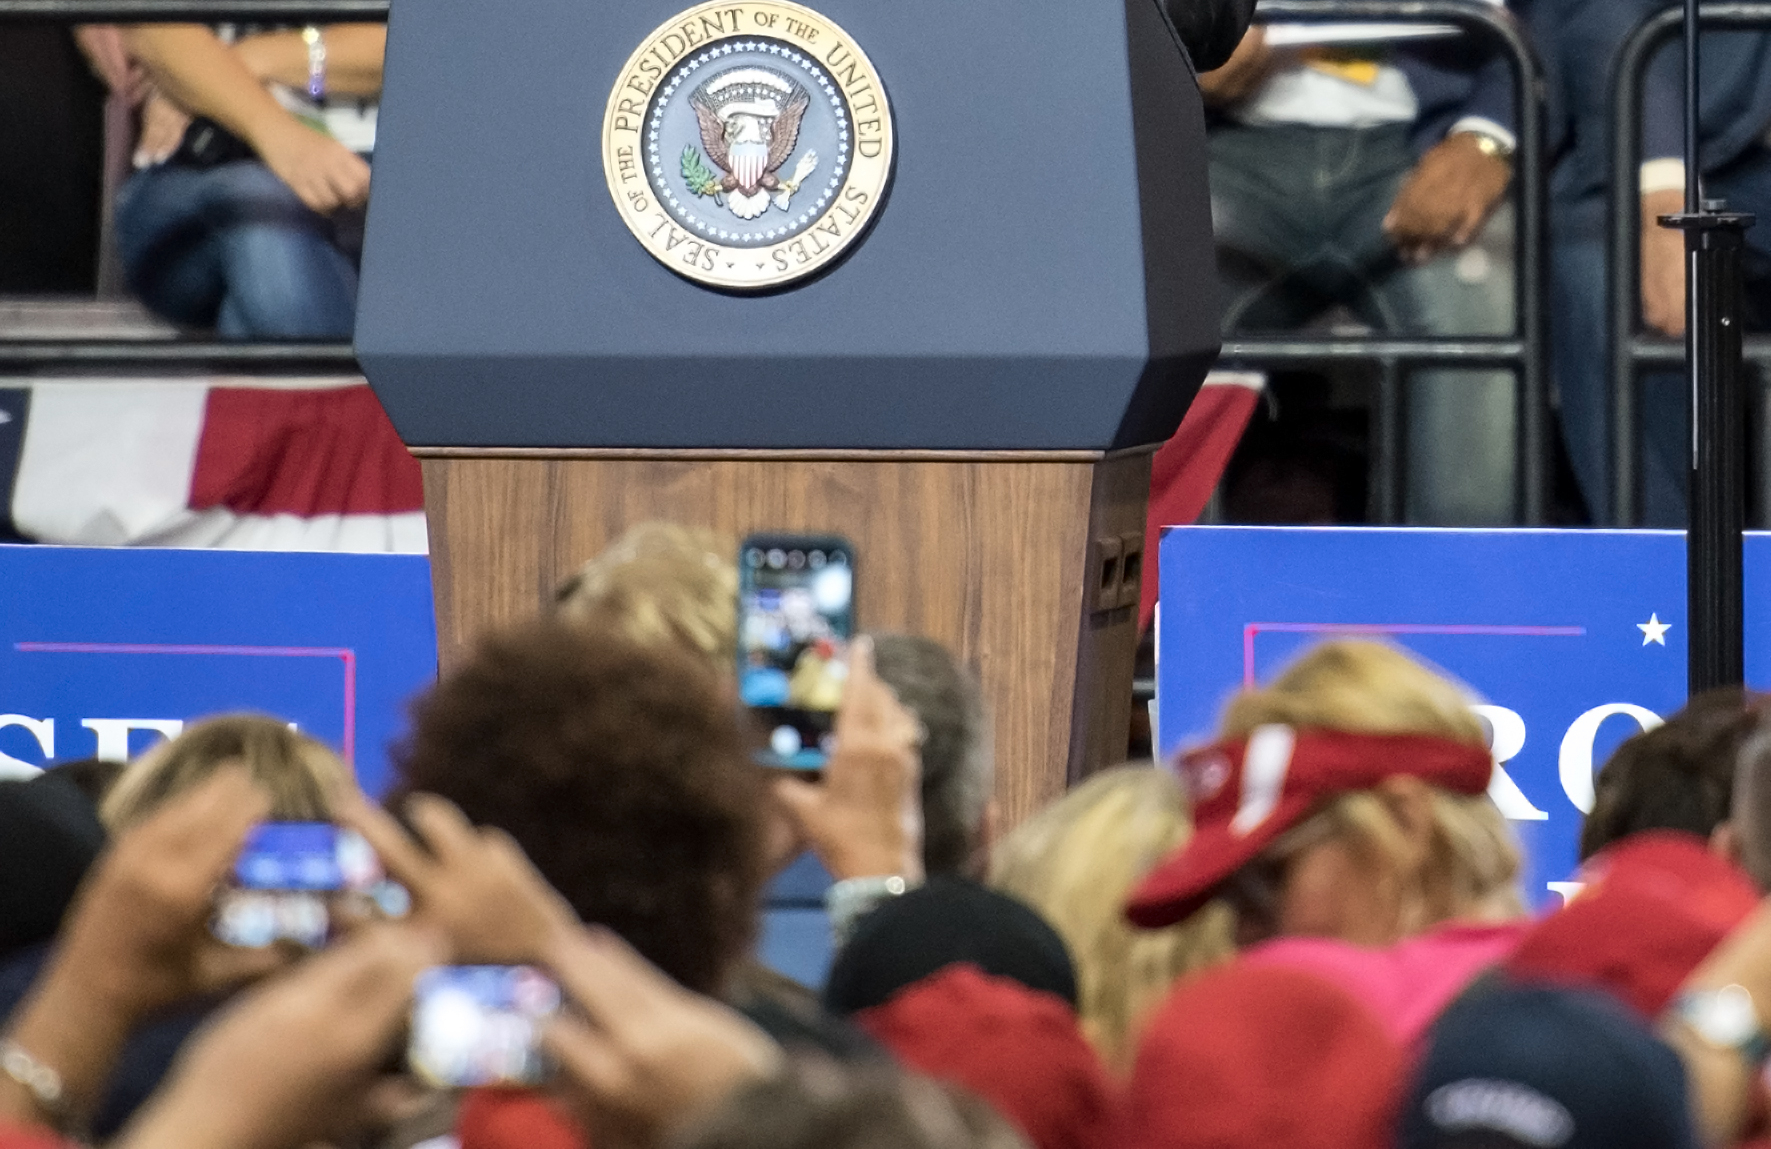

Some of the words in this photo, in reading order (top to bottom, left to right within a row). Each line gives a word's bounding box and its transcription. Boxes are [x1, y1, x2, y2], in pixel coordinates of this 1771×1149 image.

[753, 11, 780, 28] OF
[785, 16, 820, 44] THE
[614, 8, 743, 134] PRESIDENT
[825, 40, 882, 159] UNITED
[618, 145, 637, 183] THE
[627, 190, 649, 213] OF
[649, 212, 720, 272] SEAL
[771, 186, 869, 272] STATES
